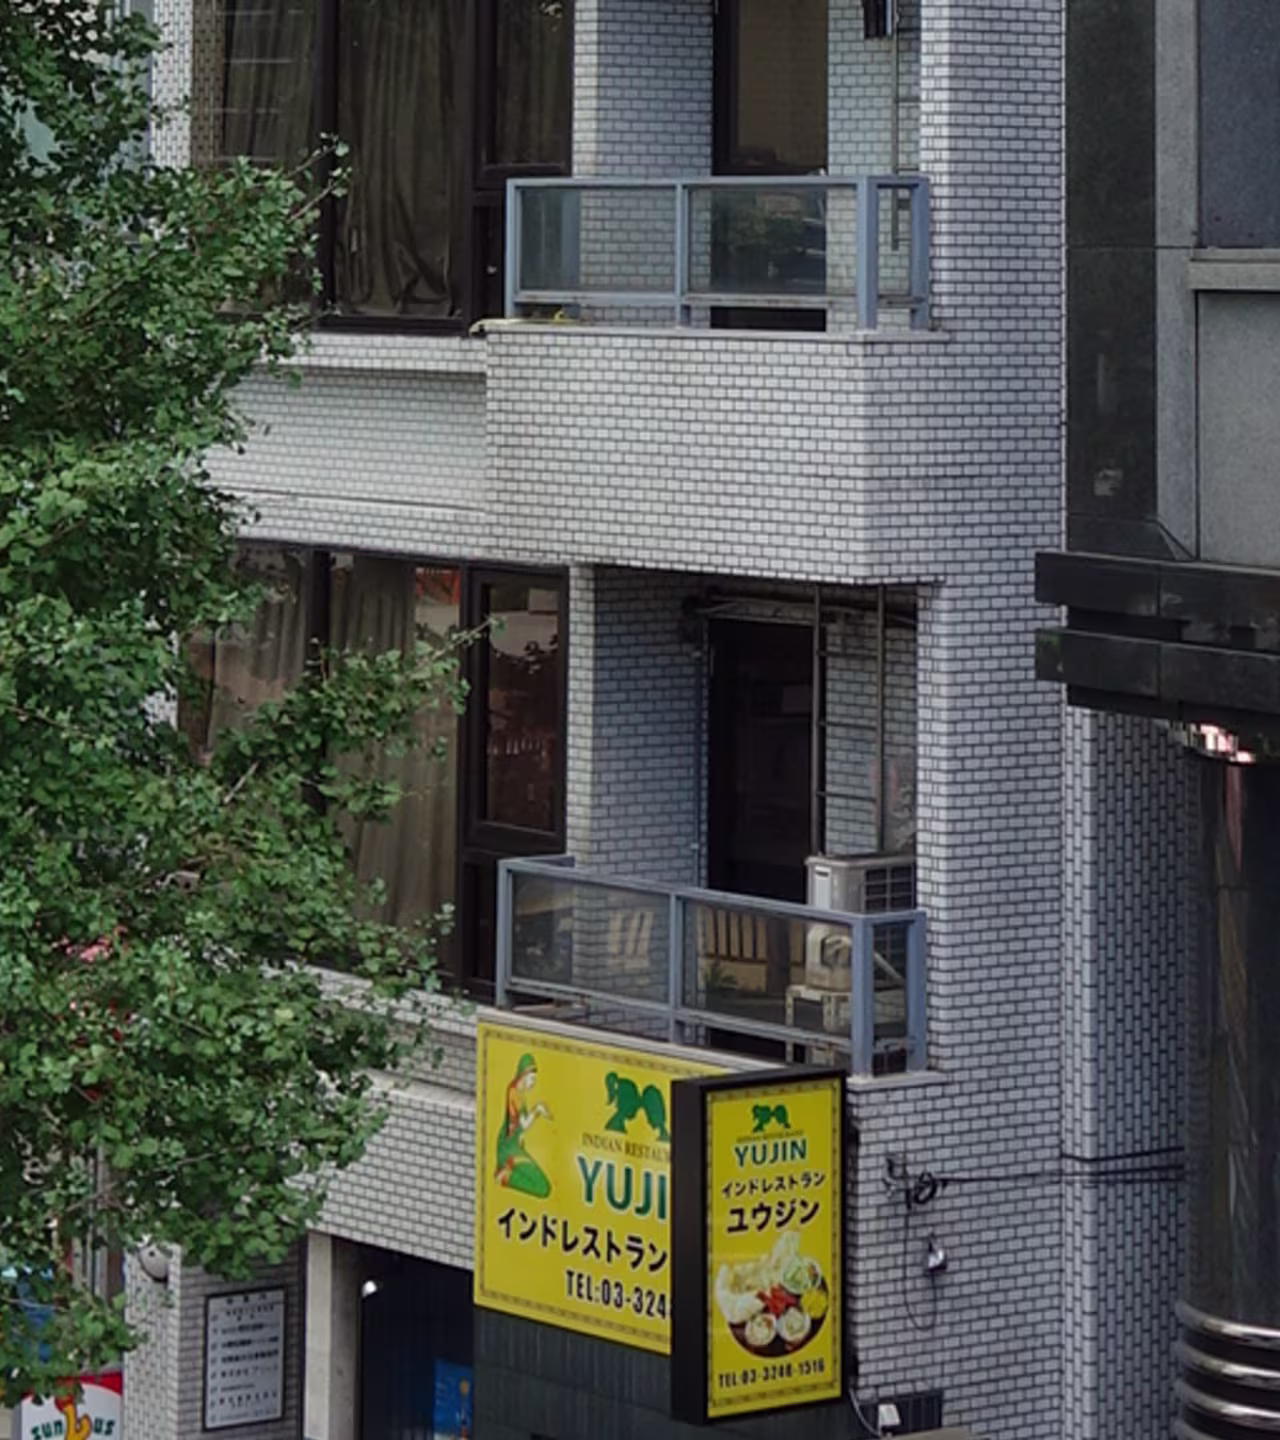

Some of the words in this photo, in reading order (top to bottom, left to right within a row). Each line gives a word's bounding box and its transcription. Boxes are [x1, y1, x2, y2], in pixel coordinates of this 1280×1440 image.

[582, 1132, 622, 1152] INDIAN
[735, 1139, 806, 1167] YUJIN
[577, 1156, 667, 1220] YUJI
[722, 1171, 825, 1198] インドレストラン
[727, 1199, 819, 1233] ユウジン
[498, 1208, 668, 1272] インドレストラン
[566, 1270, 669, 1320] TEL:03-324
